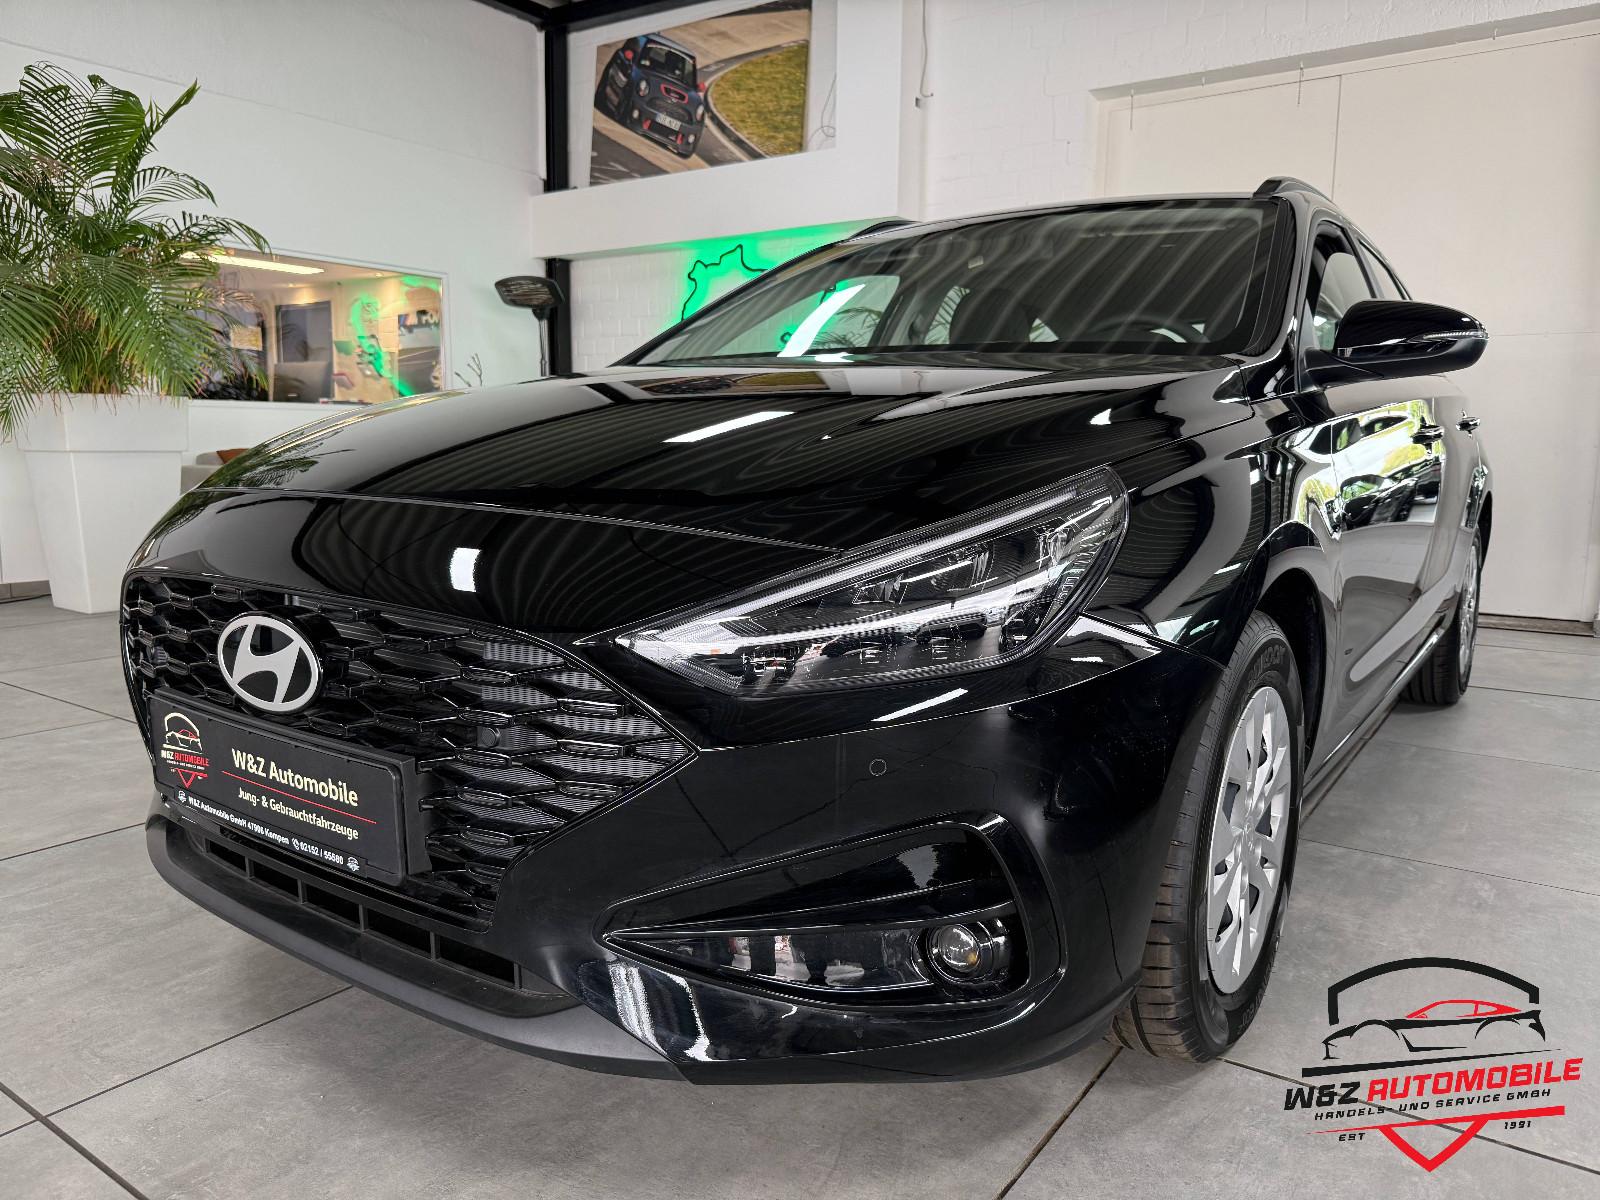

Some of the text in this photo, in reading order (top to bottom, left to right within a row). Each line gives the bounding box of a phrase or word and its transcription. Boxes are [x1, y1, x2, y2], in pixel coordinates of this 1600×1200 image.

[174, 752, 209, 766] AUTOMOBILE
[232, 748, 359, 807] W&Z Automobile
[188, 796, 201, 808] W&Z
[200, 801, 230, 821] Automobile
[229, 813, 247, 828] GmbH
[299, 841, 320, 856] 02152
[238, 787, 359, 841] Jung- & Gebrauchtfahrzeuge
